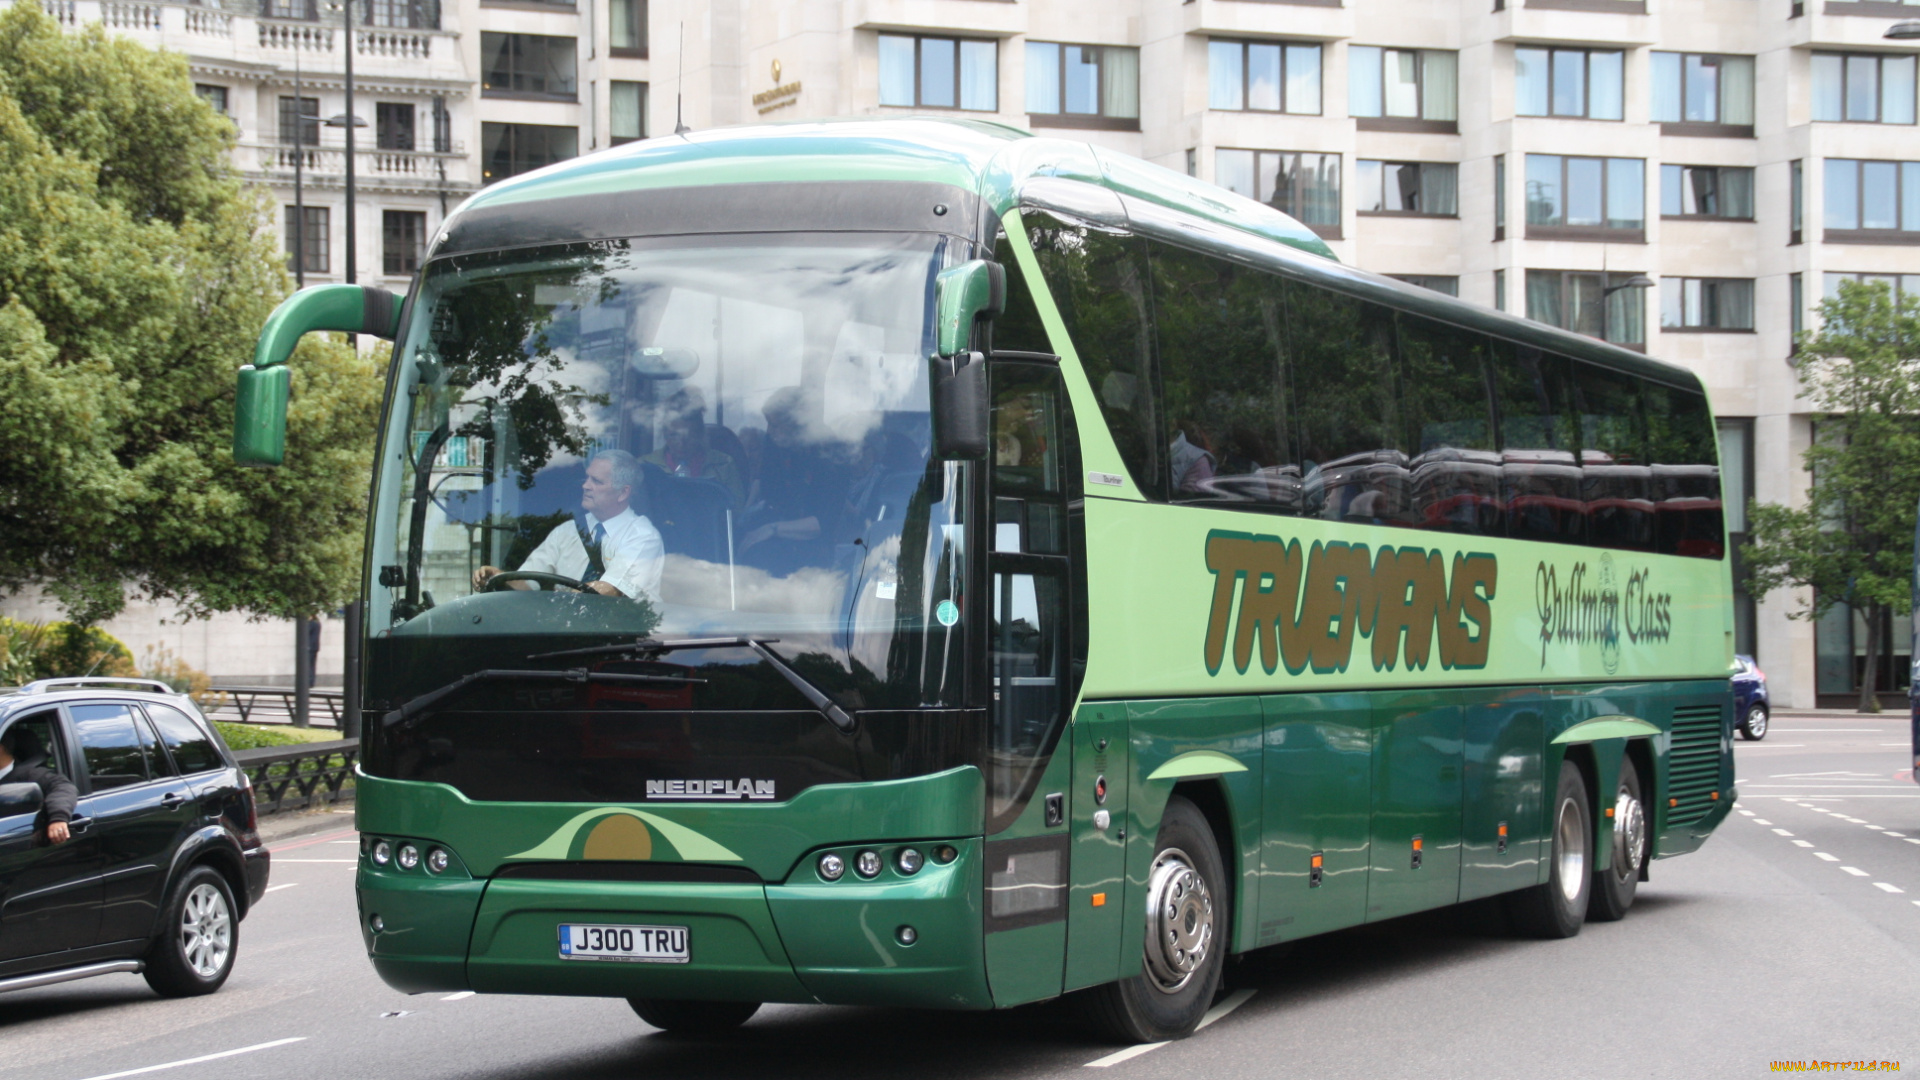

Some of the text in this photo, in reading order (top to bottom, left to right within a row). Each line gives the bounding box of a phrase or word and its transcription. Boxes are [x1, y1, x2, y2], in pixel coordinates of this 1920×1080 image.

[1204, 528, 1498, 676] TRUEMANS
[1536, 560, 1672, 672] Pullman Class
[646, 778, 775, 799] NEOPLAN
[576, 928, 685, 953] J300 TRU
